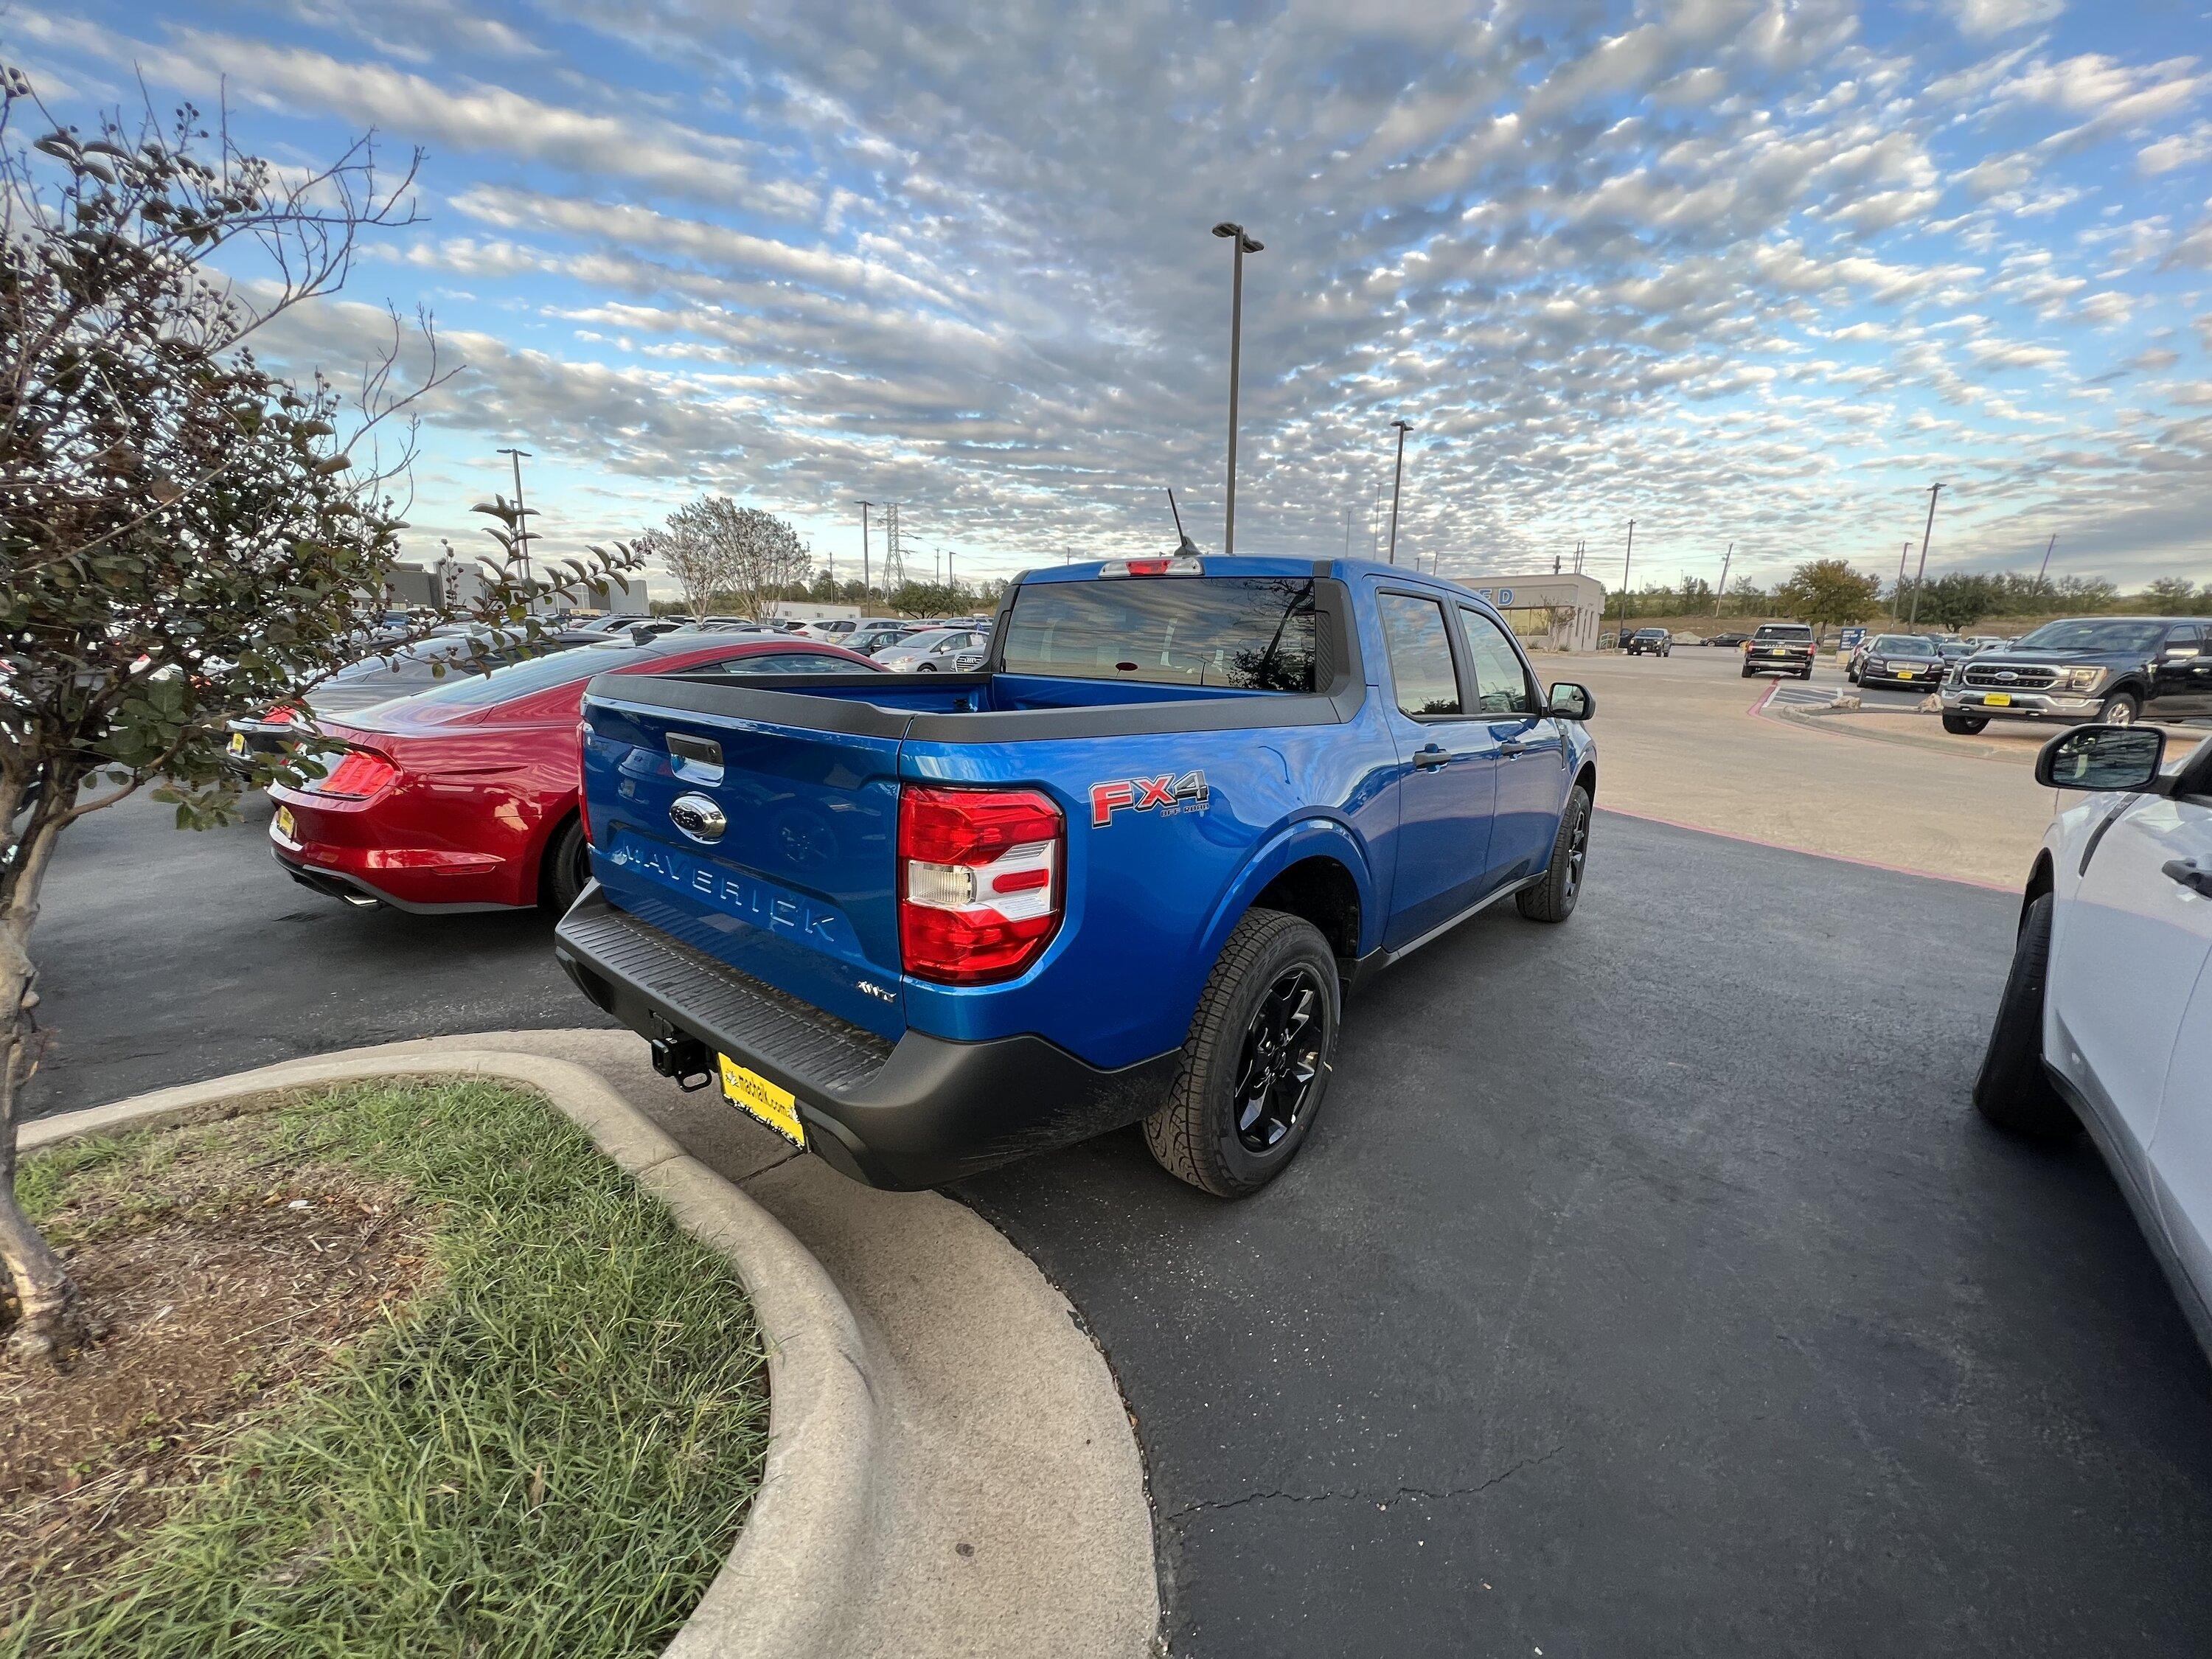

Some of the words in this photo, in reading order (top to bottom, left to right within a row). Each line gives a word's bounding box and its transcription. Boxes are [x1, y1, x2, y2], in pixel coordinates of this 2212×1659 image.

[1088, 770, 1210, 830] FX4
[1160, 807, 1181, 818] OFF
[1183, 804, 1210, 814] ROAD
[621, 840, 835, 942] MAVERICK
